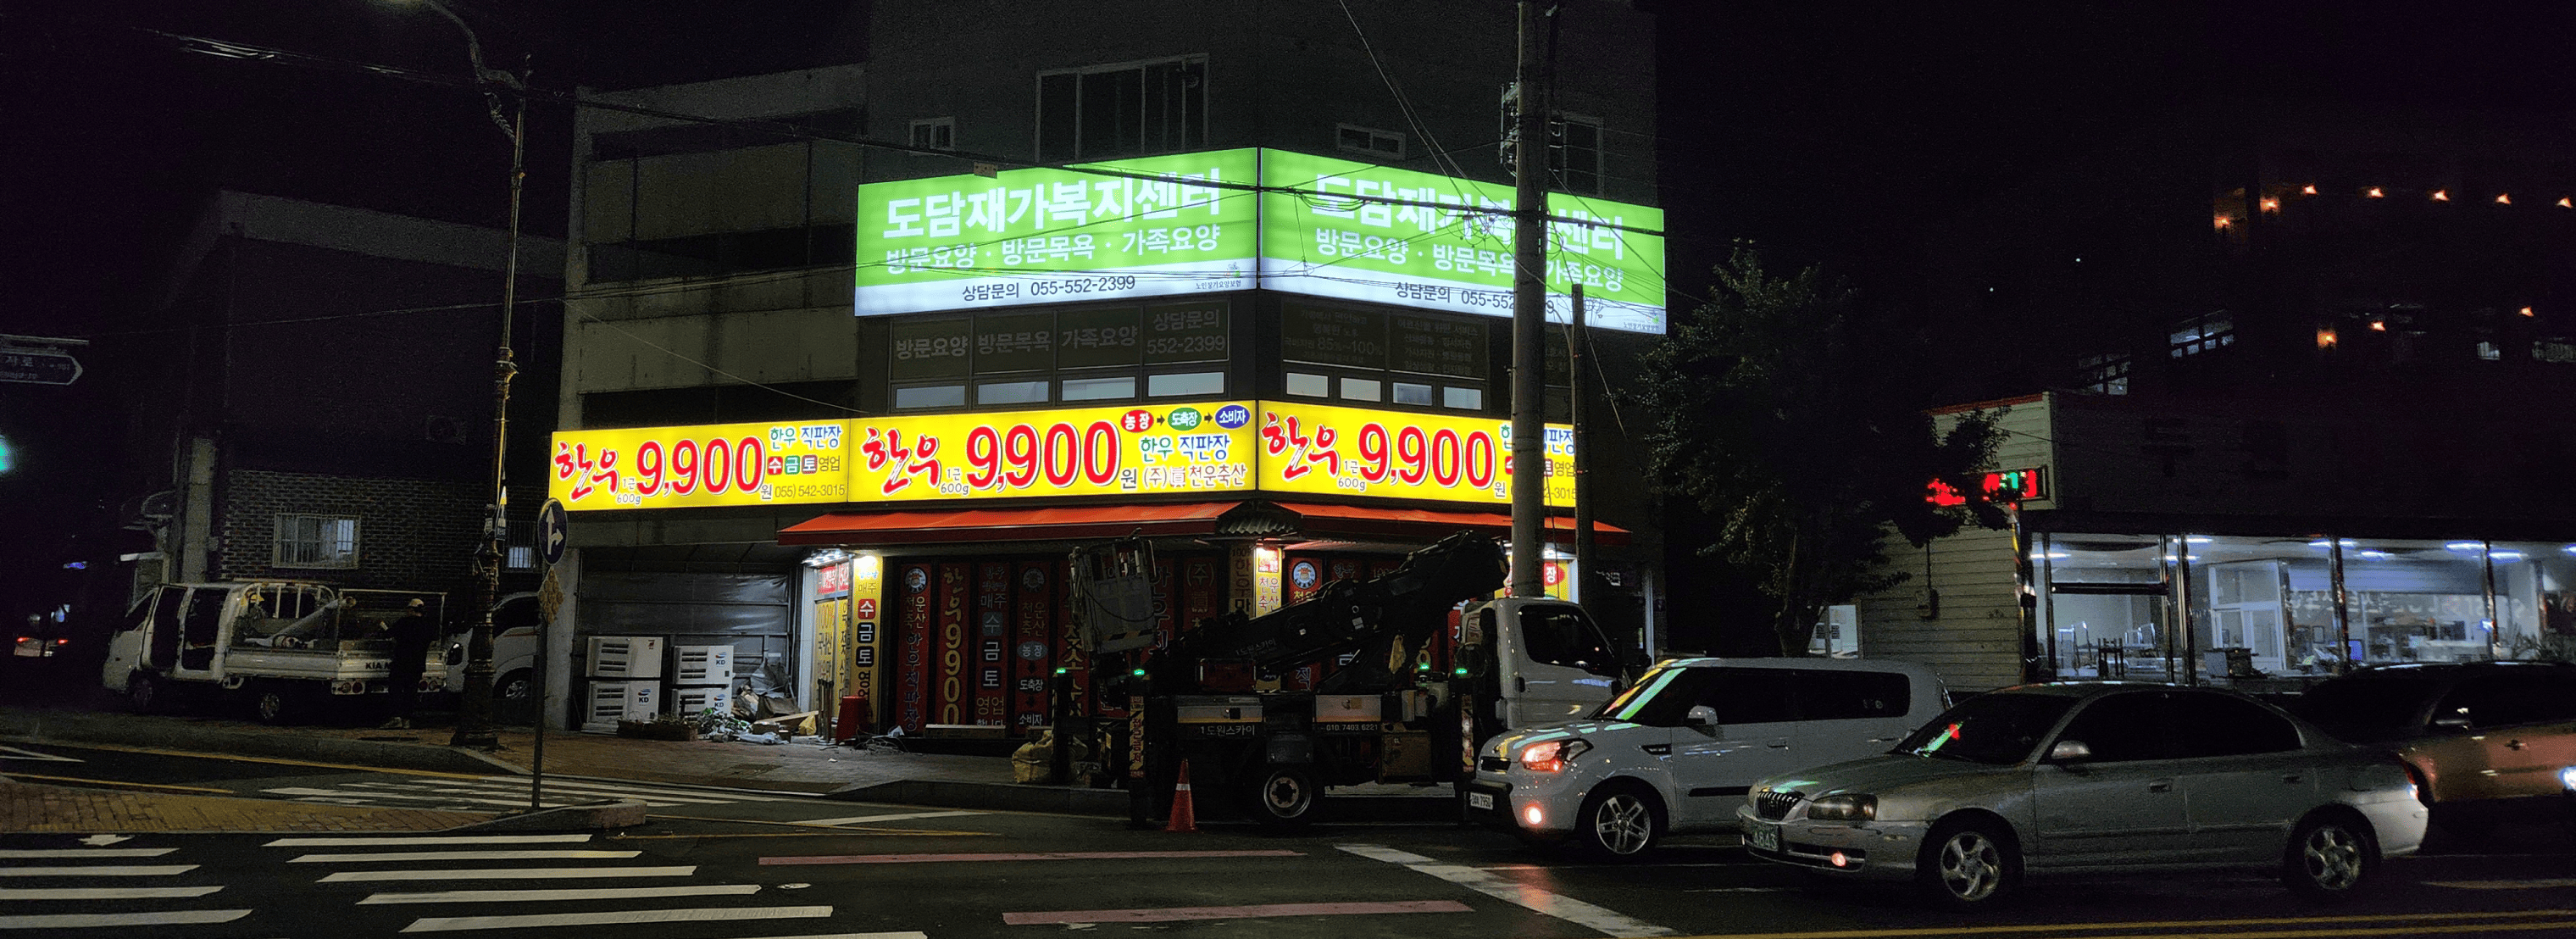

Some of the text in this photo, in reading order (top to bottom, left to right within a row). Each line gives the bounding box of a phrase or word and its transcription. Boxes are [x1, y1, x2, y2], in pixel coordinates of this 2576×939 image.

[883, 168, 1220, 238] 도담재가복지센터
[1312, 174, 1623, 260] 도담재가복센터
[886, 224, 1220, 275] 방문요양 방문목욕 가족요양
[1316, 228, 1409, 265] 방문요양
[962, 275, 1135, 303] 상담문의 055-552-2399
[1395, 281, 1451, 304] 상담문의
[1152, 308, 1220, 331] 상담문의
[896, 336, 969, 360] 방문요양
[978, 331, 1052, 354] 방문목욕
[1062, 325, 1138, 349] 가족요양
[1147, 335, 1226, 356] 552-2399
[1170, 411, 1198, 427] 도축장
[1219, 409, 1246, 425] 소비자
[769, 425, 842, 449] 한우 직판장
[1544, 428, 1575, 454] 판장
[863, 420, 1137, 495] 한우 1근 9,900 원
[1141, 435, 1230, 463] 한우 직판장
[1261, 411, 1341, 481] 한우
[1345, 459, 1359, 474] 1근
[1359, 423, 1496, 489] 9,900
[1495, 481, 1506, 497] 원
[555, 436, 773, 502] 한우 1근 9,900 원
[798, 484, 846, 498] 542-3015
[941, 481, 969, 496] 600g
[1338, 476, 1367, 492] 600g
[1544, 486, 1576, 499] 2-3015
[617, 493, 641, 506] 600g
[858, 581, 877, 594] 매주
[980, 592, 1007, 609] 매주
[1019, 679, 1044, 692] 도축장
[976, 696, 1004, 715] 영업
[1018, 713, 1043, 726] 소비자
